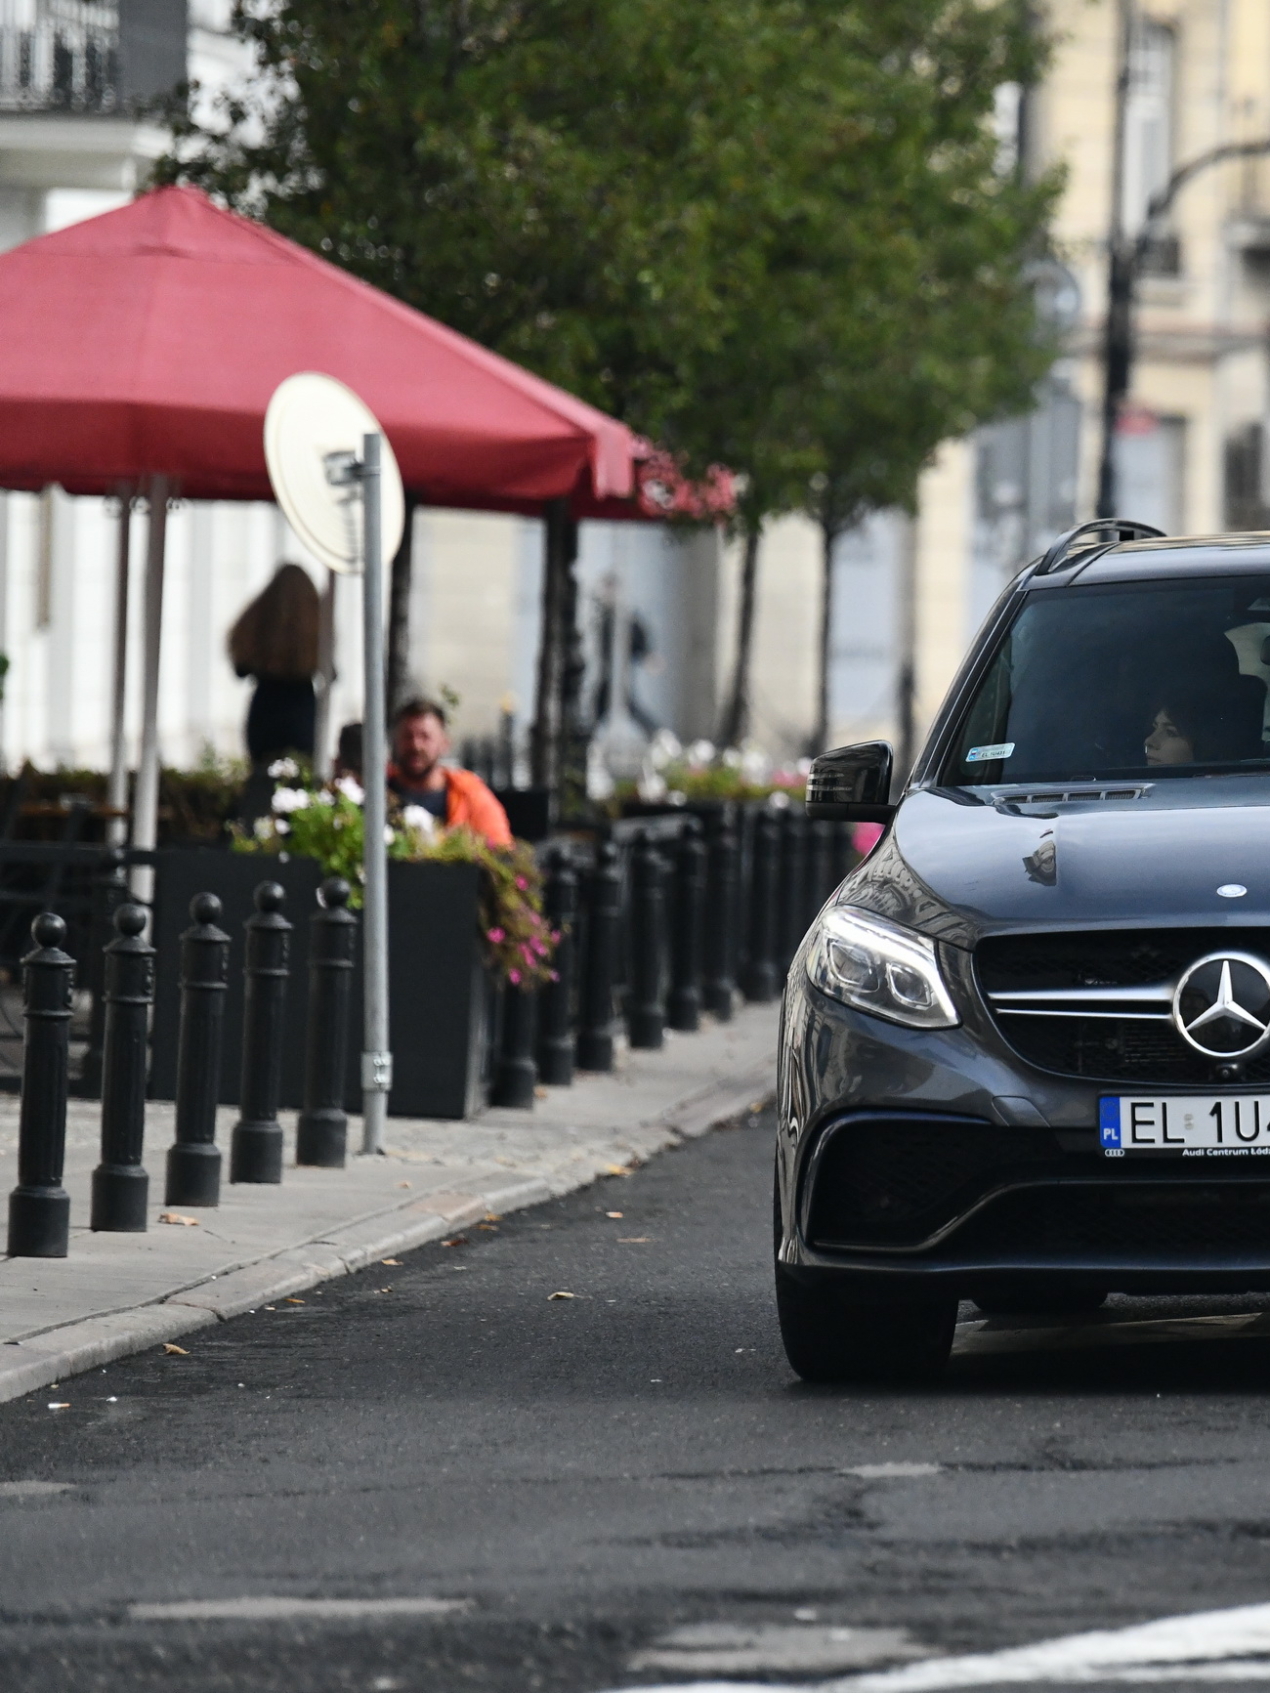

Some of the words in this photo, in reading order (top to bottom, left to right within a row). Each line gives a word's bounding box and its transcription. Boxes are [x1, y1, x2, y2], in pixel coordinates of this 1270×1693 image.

[1131, 1102, 1185, 1144] EL
[1103, 1128, 1119, 1140] PL
[1182, 1148, 1204, 1156] Audi
[1206, 1148, 1249, 1156] Centrum
